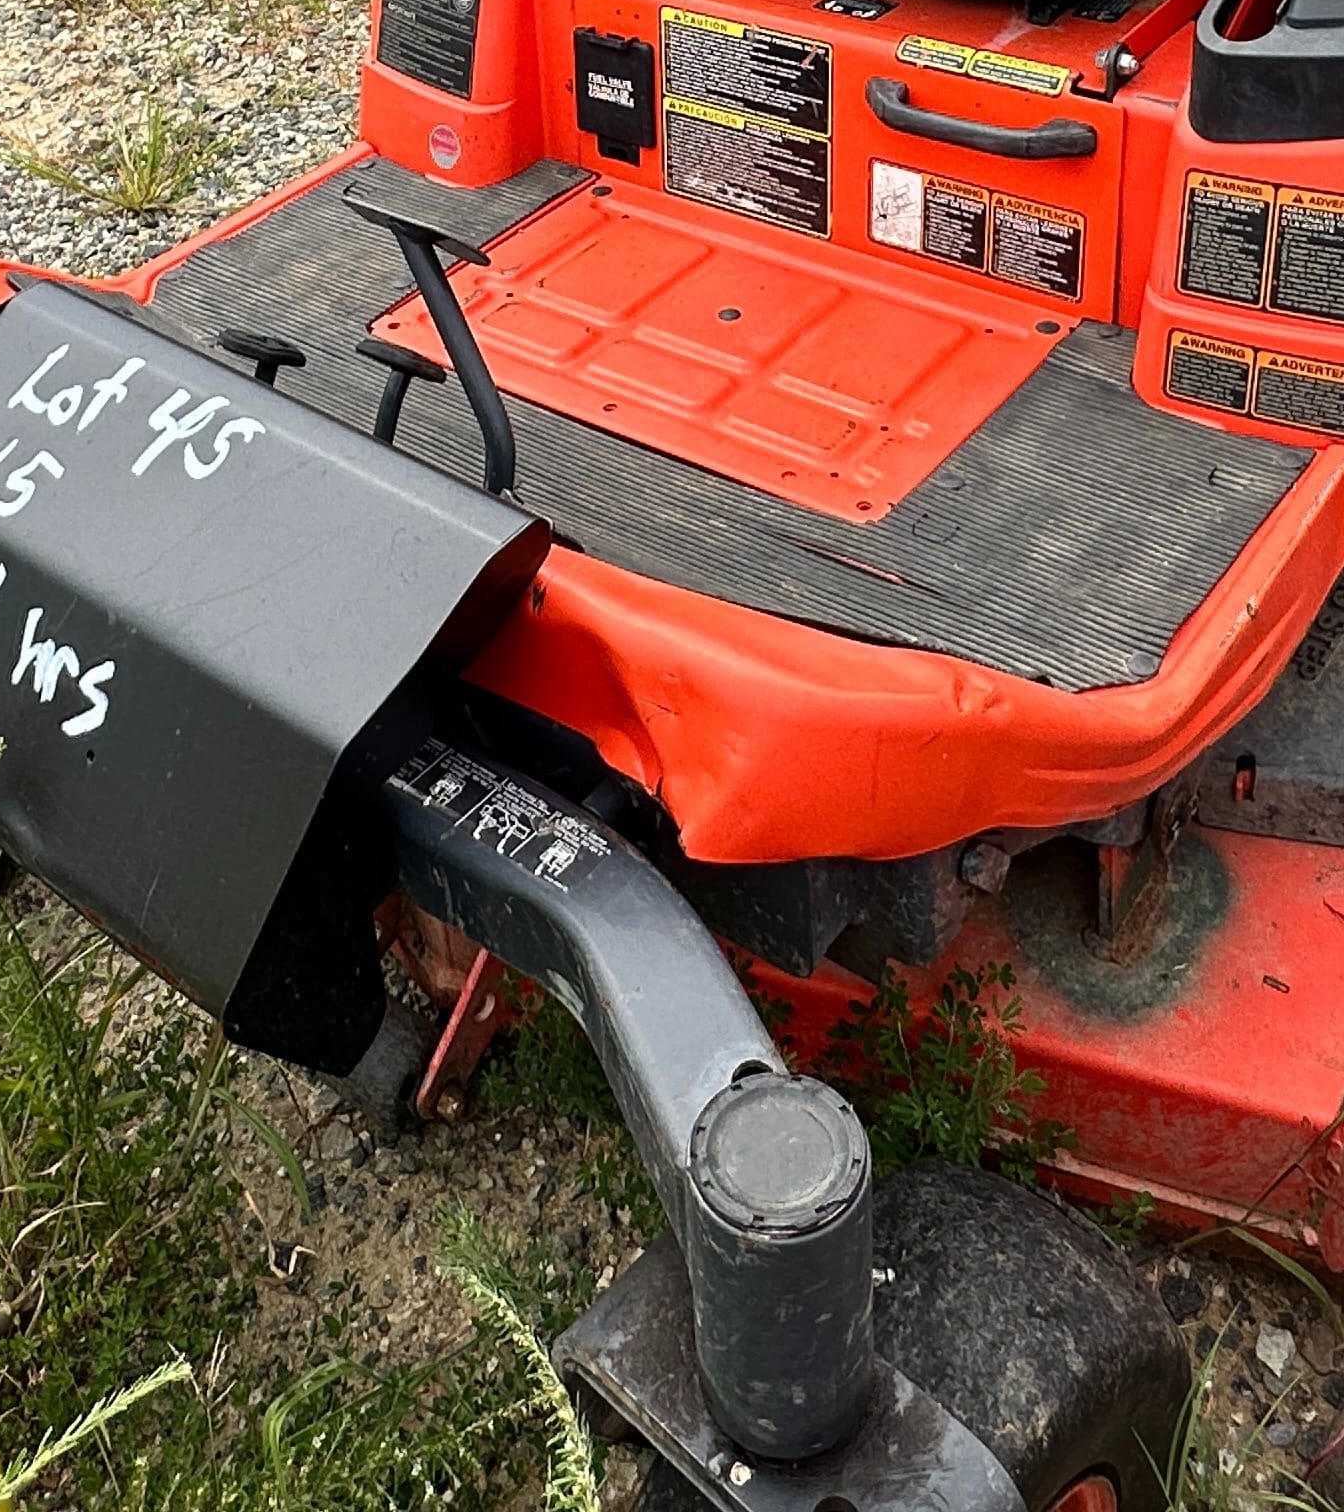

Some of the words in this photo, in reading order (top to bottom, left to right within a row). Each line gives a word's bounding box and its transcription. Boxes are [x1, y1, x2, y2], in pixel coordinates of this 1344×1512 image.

[683, 13, 728, 32] CAUTION
[936, 179, 984, 199] WARNING
[1212, 179, 1263, 195] WARNING
[1006, 199, 1080, 227] ADVERTENCIA
[1190, 337, 1246, 359] WARNING
[9, 344, 146, 433] Lot
